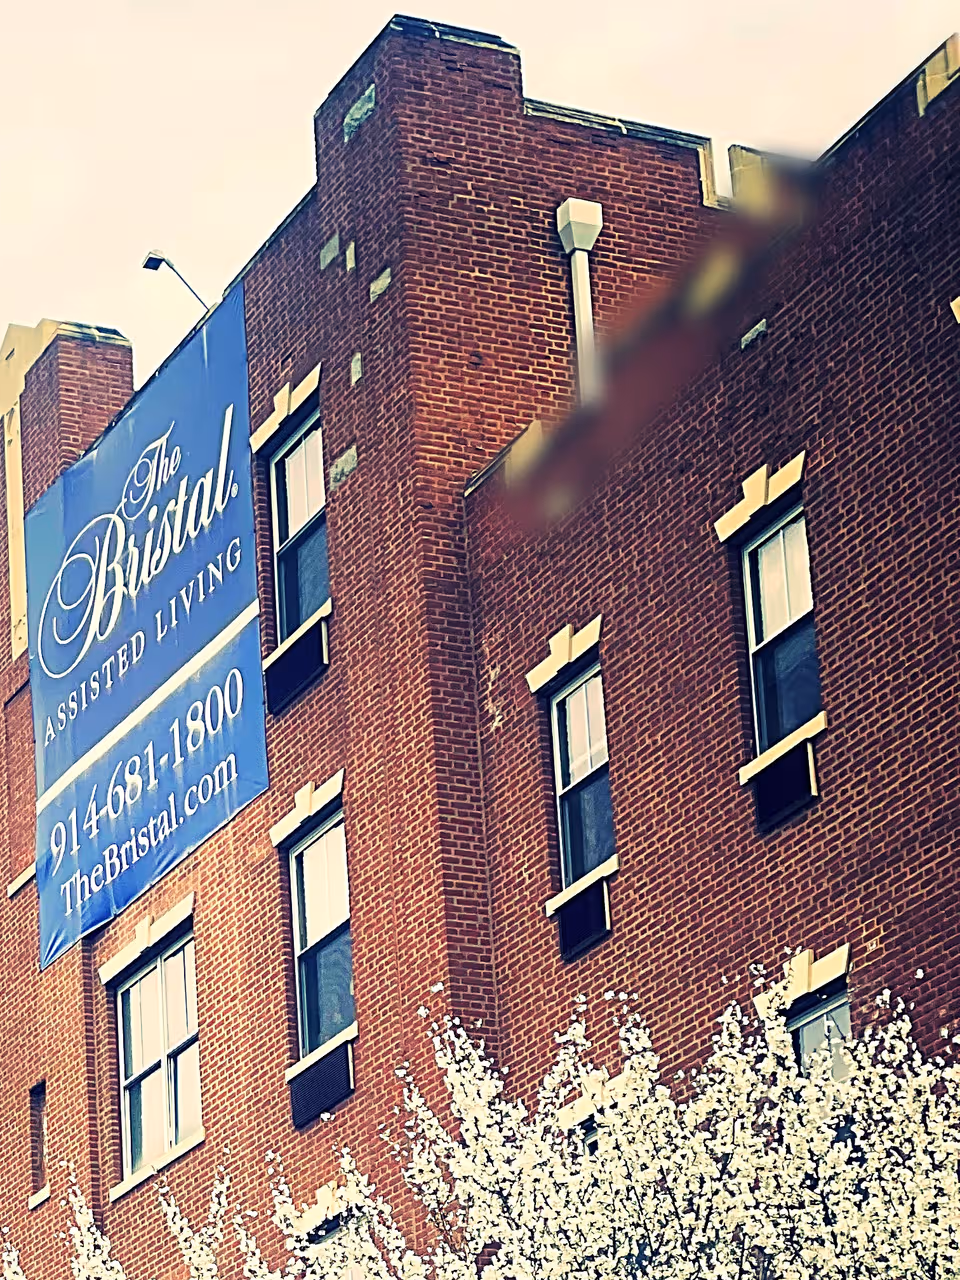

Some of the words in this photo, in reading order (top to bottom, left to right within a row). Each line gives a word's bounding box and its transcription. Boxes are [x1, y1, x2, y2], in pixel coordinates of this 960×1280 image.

[122, 421, 181, 520] The
[45, 630, 145, 747] ASSISTED
[155, 537, 241, 642] LIVING
[50, 668, 243, 876] 914-681-1800
[61, 754, 238, 917] TheBristal.com
